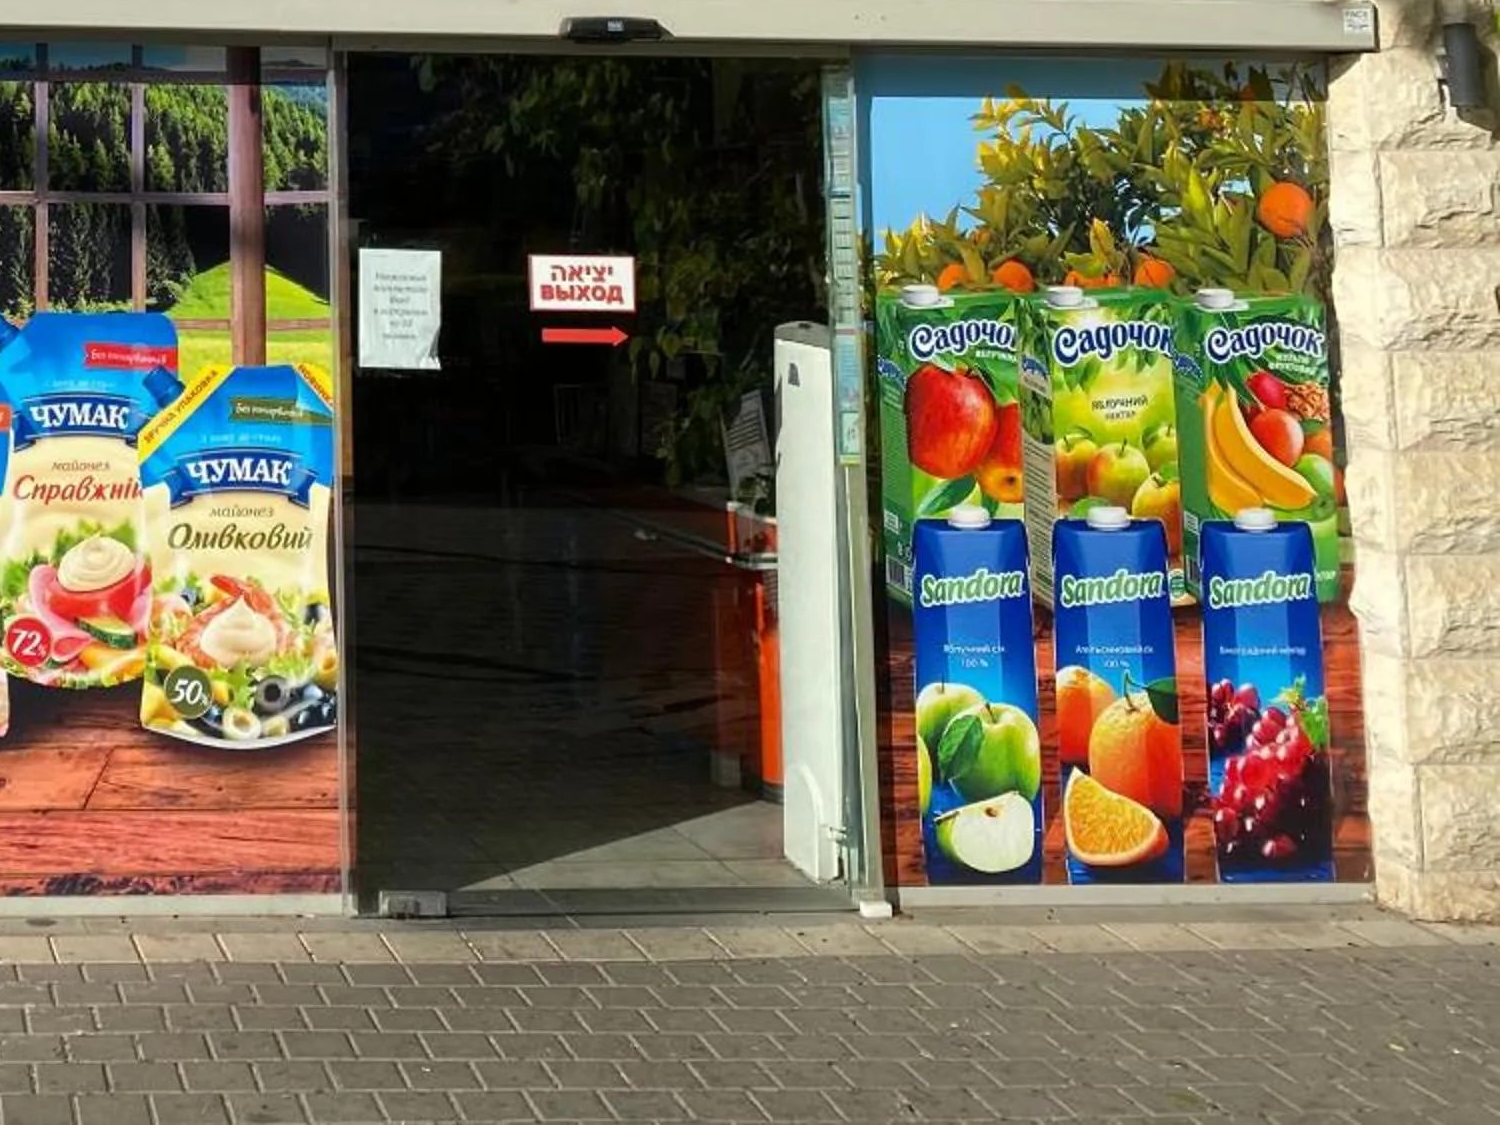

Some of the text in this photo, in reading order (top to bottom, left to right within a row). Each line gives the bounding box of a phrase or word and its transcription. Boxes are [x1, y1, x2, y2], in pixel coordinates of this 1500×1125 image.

[550, 265, 613, 282] יציאה
[541, 284, 624, 304] ВЫХОД
[909, 319, 1018, 362] Садочо
[1205, 322, 1325, 364] Садочок
[29, 402, 131, 430] ЧУМАК
[52, 459, 111, 472] майонез
[186, 457, 293, 486] ЧУМАК
[209, 504, 276, 518] майонез
[167, 522, 315, 551] Оливковий
[920, 568, 1025, 607] Sandora
[1061, 568, 1165, 608] Sandora
[1209, 570, 1313, 610] Sandora
